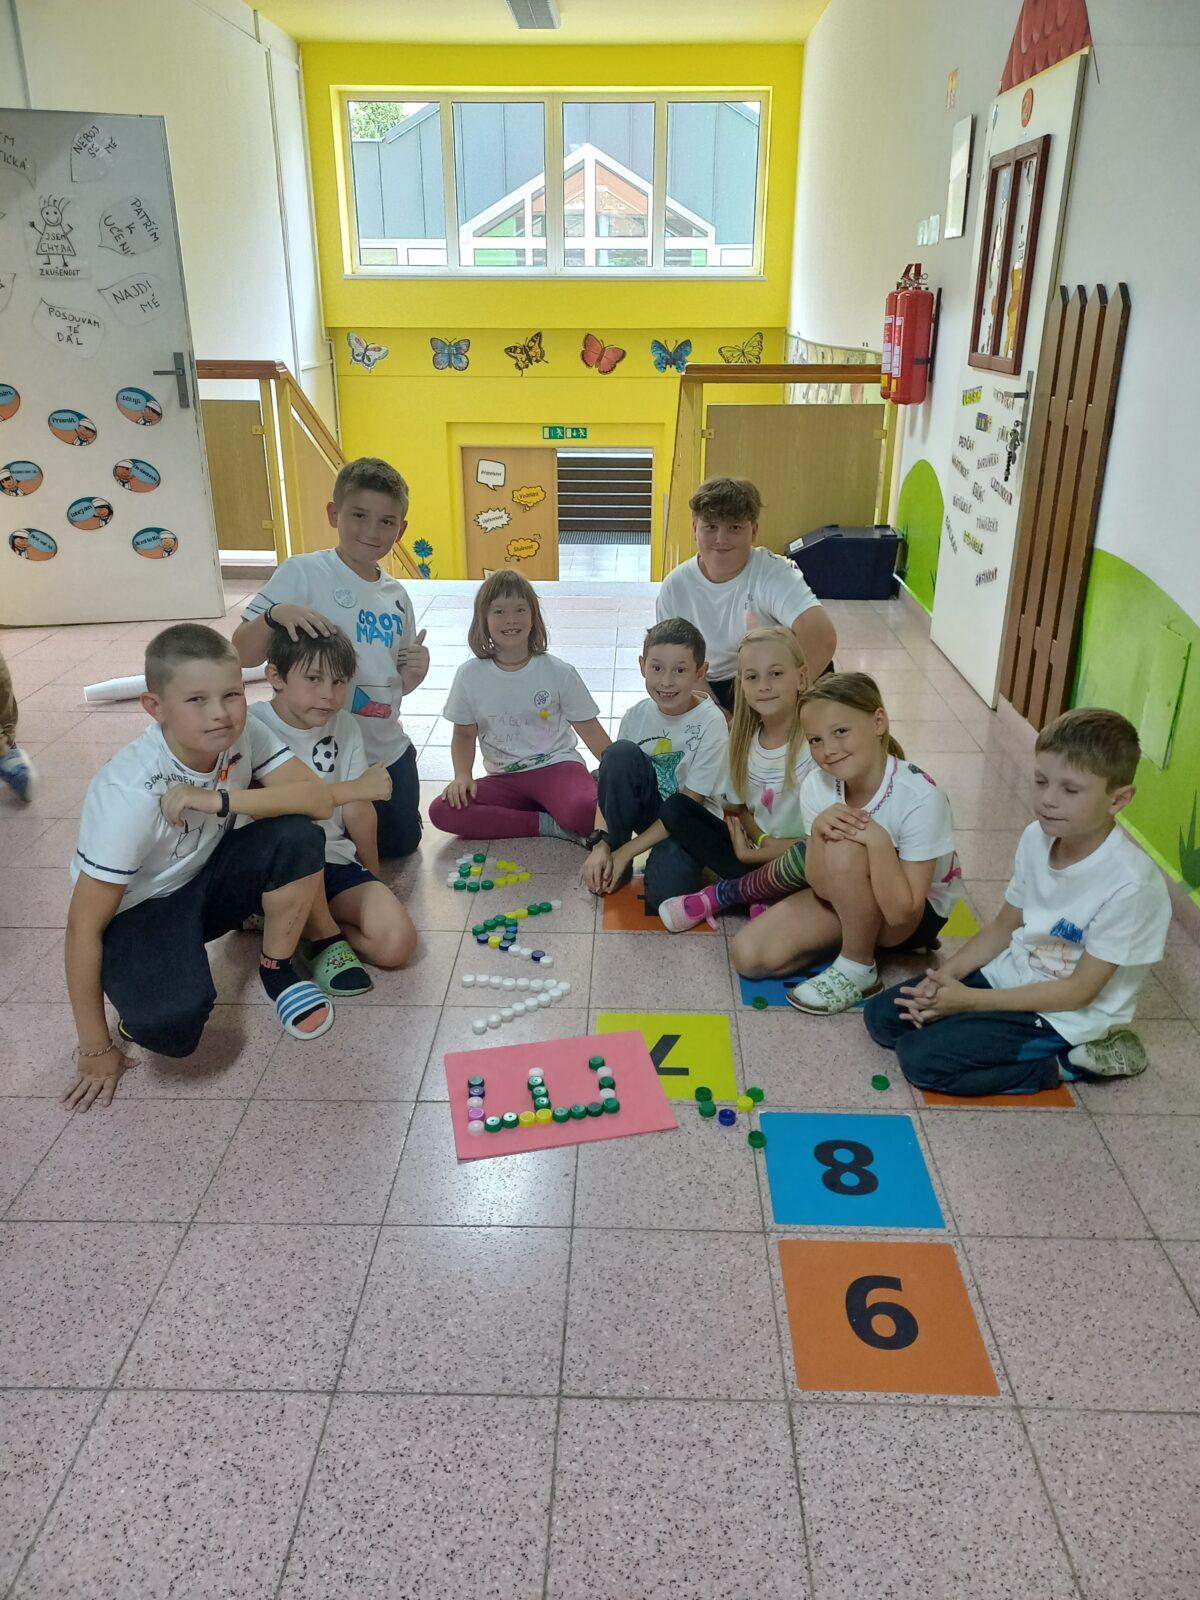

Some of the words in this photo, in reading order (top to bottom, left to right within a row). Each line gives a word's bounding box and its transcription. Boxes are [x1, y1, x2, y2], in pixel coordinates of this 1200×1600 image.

[72, 124, 100, 155] NEBOJ
[125, 221, 136, 235] K
[112, 280, 152, 304] NAJDI
[813, 1138, 879, 1196] 8
